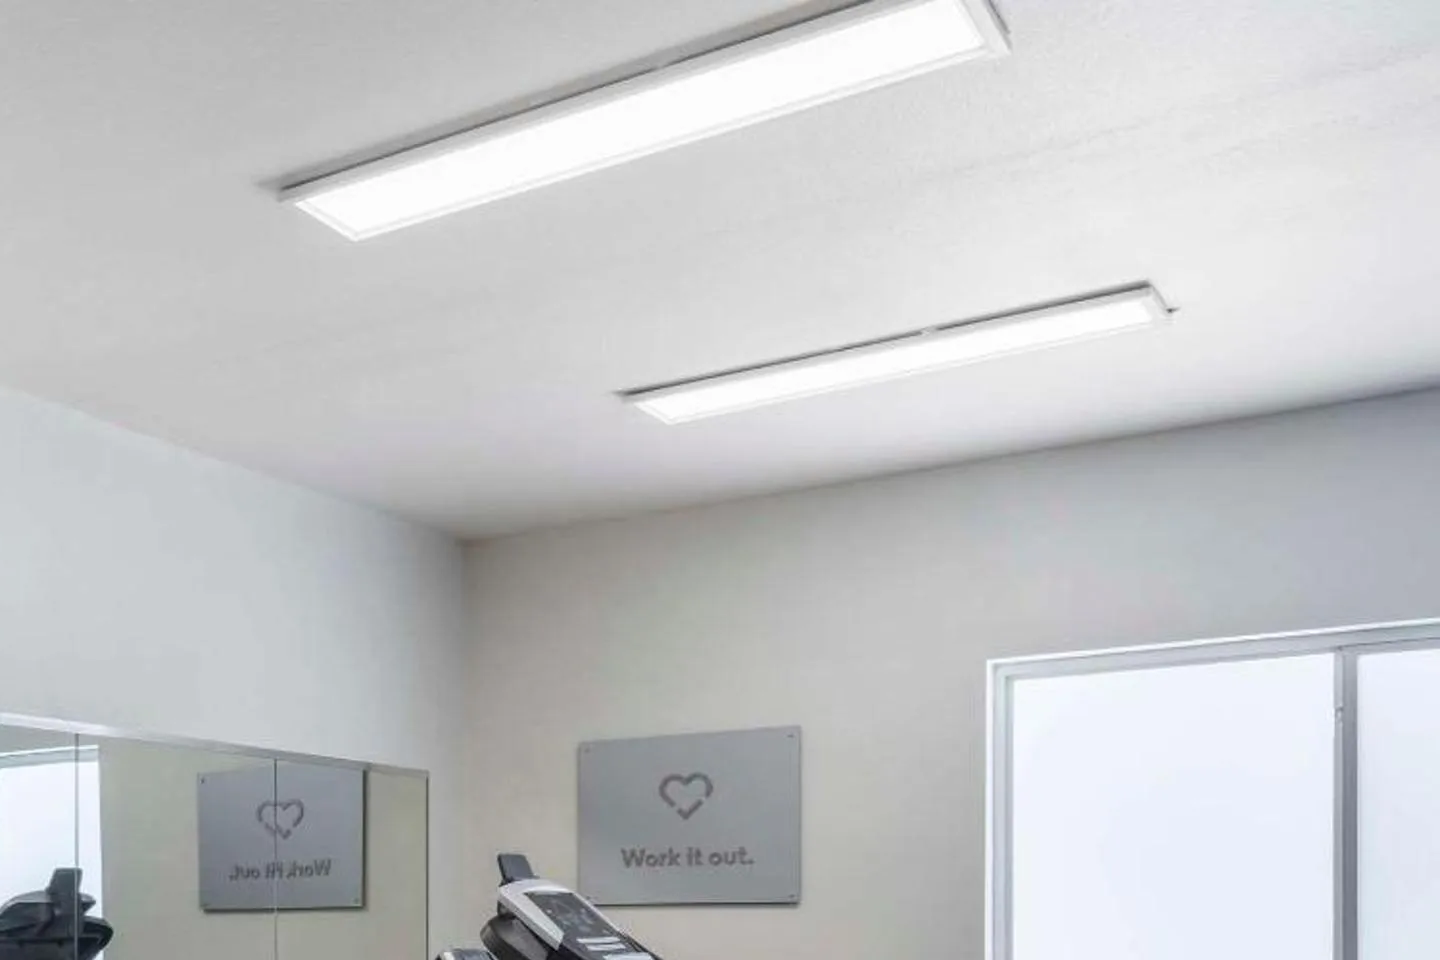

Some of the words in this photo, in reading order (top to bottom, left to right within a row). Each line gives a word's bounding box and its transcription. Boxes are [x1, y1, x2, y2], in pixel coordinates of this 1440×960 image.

[620, 846, 680, 868] Work
[686, 846, 703, 866] it
[708, 846, 755, 866] out.
